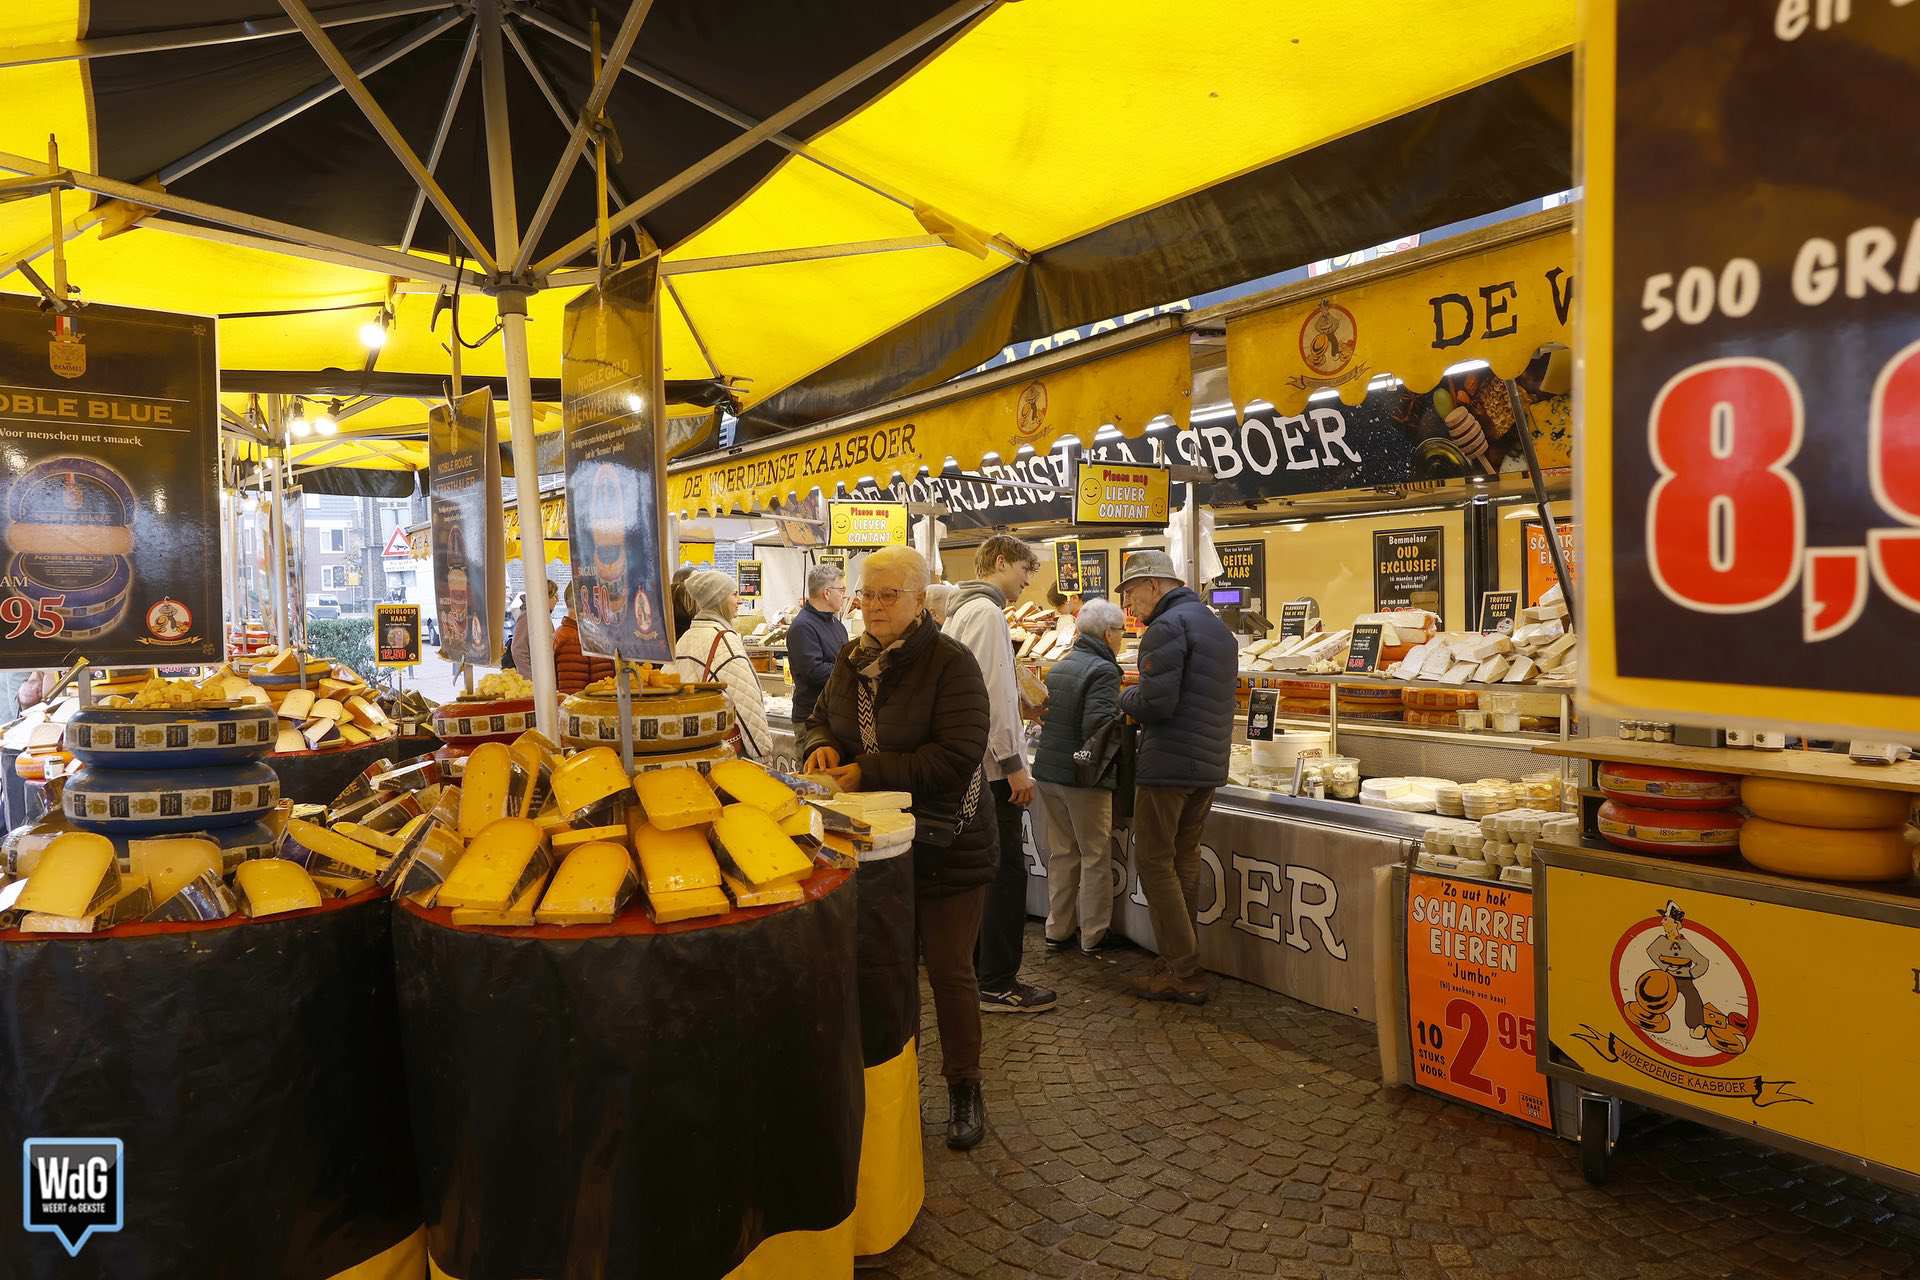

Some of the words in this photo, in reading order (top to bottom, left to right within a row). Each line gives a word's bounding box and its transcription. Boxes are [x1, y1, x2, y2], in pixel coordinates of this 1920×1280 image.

[1641, 257, 1760, 332] 500
[1429, 280, 1518, 349] DE
[88, 400, 174, 425] BLUE
[82, 435, 101, 443] met
[683, 474, 703, 499] DE
[709, 453, 800, 498] WOERDENSE
[802, 423, 916, 477] KAASBOER
[1105, 486, 1145, 502] LIEVER
[1099, 503, 1150, 518] CONTANT
[854, 519, 886, 530] LIEVER
[848, 532, 891, 543] CONTANT
[1388, 533, 1427, 545] Bemmelaer
[1397, 545, 1419, 559] OUD
[1223, 553, 1253, 566] GEITEN
[1380, 558, 1437, 574] EXCLUSIEF
[1227, 566, 1250, 578] KAAS
[1090, 576, 1102, 587] VET
[1489, 595, 1513, 603] TRUFFEL
[1490, 602, 1510, 610] GEITEN
[0, 594, 65, 640] 95
[1492, 609, 1507, 617] KAAS
[1462, 888, 1481, 902] uut
[1430, 927, 1517, 973] EIEREN
[1417, 1020, 1443, 1050] 10
[1418, 1049, 1446, 1064] STUKS
[1621, 1049, 1685, 1086] WOERDENSE
[1687, 1075, 1747, 1093] KAASBOER
